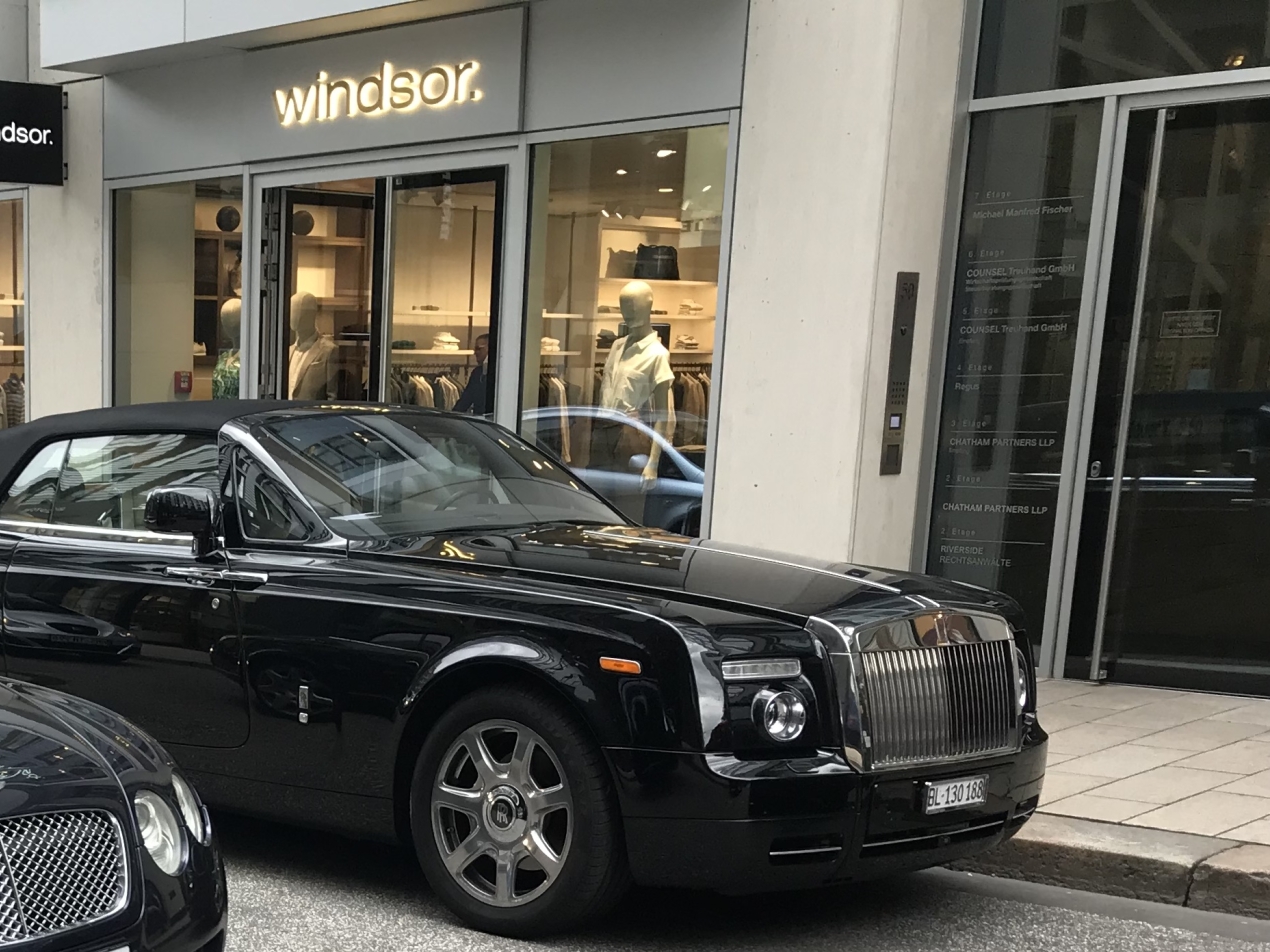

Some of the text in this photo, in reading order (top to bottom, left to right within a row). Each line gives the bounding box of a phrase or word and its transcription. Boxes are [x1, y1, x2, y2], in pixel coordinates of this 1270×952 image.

[272, 60, 483, 126] windsor.
[972, 205, 1073, 219] Michael Manfred Fischer
[966, 263, 1075, 278] COUNSEL Treuhand GmbH
[960, 323, 1067, 334] COUNSEL Treuhand GmbH
[954, 382, 980, 392] Regus
[949, 438, 1056, 447] CHATHAM PARTNERS LLP
[942, 503, 1048, 515] CHATHAM PARTNERS LLP
[940, 544, 984, 555] RIVERSIDE
[965, 780, 984, 801] 188
